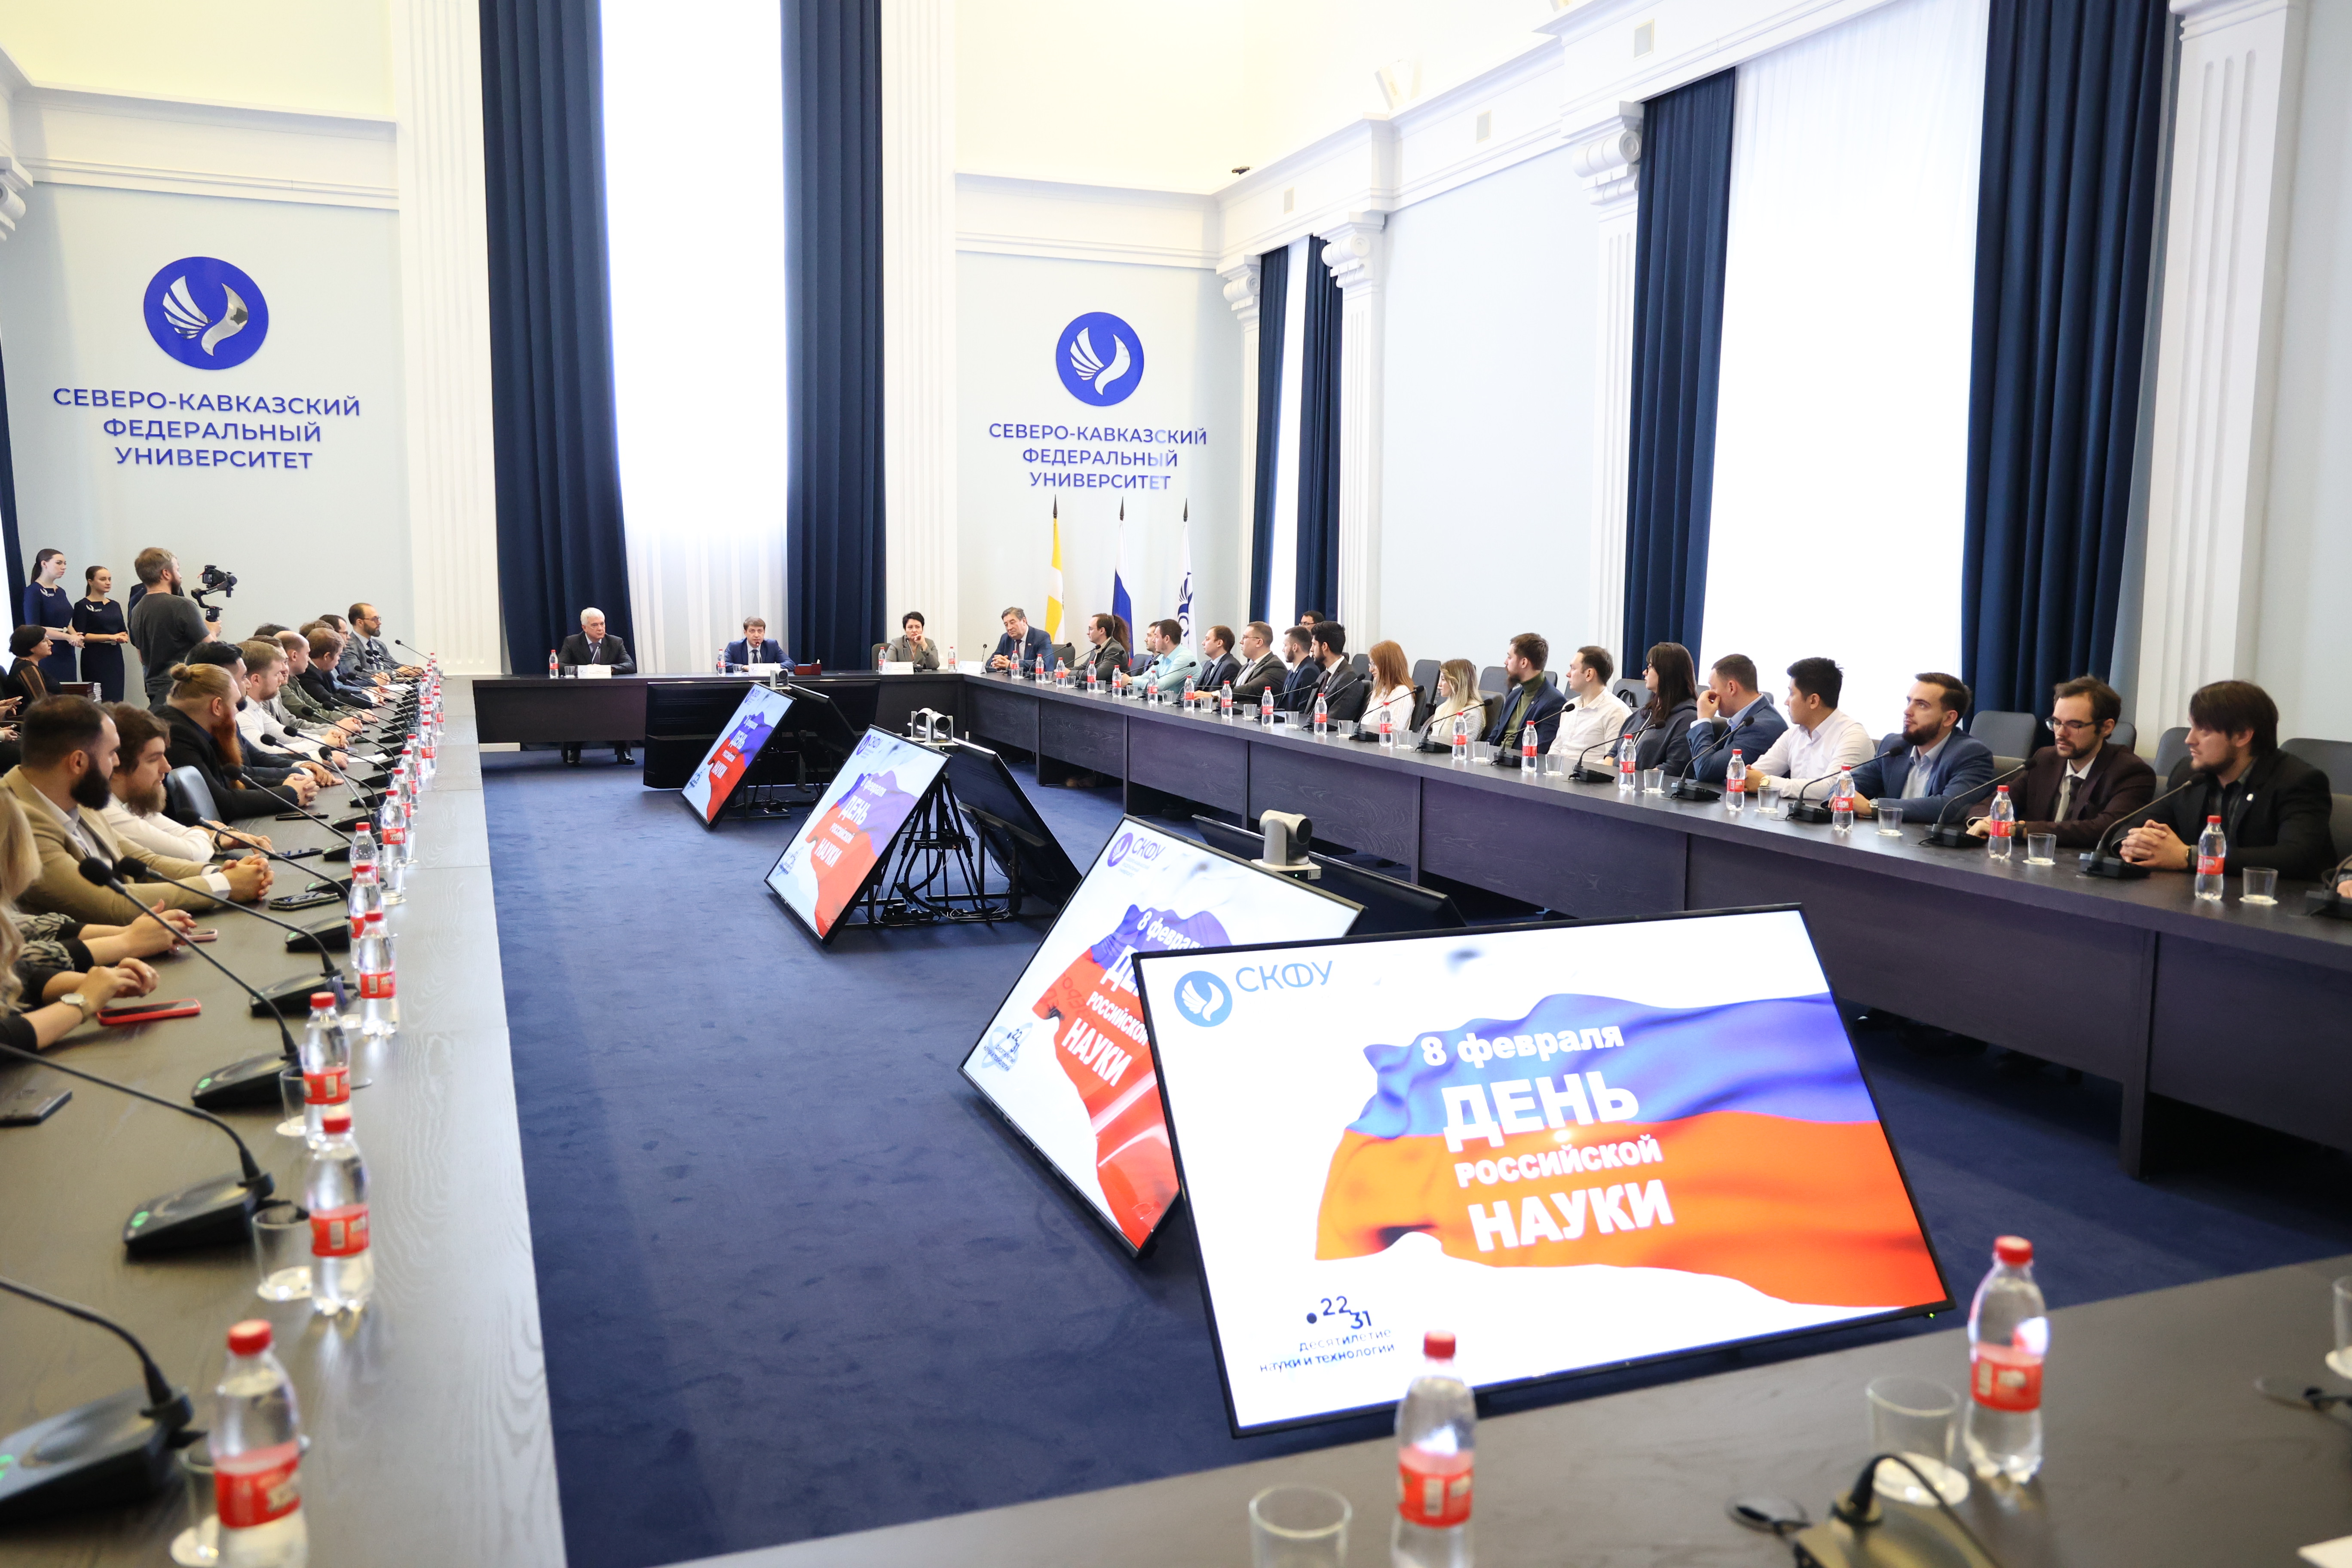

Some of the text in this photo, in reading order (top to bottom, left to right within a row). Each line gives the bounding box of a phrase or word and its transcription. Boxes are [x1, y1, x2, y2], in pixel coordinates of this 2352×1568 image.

[53, 388, 360, 416] СЕВЕРО-КАВКАЗСКИЙ
[103, 418, 321, 442] ФЕДЕРАЛЬНЫЙ
[989, 423, 1207, 444] СЕВЕРО-КАВКАЗСКИЙ
[114, 447, 313, 469] УНИВЕРСИТЕТ
[1023, 448, 1177, 467] ФЕДЕРАЛЬНЫЙ
[1029, 472, 1171, 490] УНИВЕРСИТЕТ
[861, 775, 887, 797] 8 февраля
[838, 795, 871, 825] ДЕНЬ
[830, 822, 855, 844] РОССИЙСКОЙ
[814, 838, 842, 867] НАУКИ
[1132, 838, 1166, 861] СКФУ
[1137, 911, 1152, 931] 8
[1236, 961, 1332, 992] СКФУ
[1061, 1017, 1132, 1087] НАУКИ
[1421, 1026, 1624, 1069] 8 февраля
[1441, 1071, 1639, 1152] ДЕНЬ
[1454, 1133, 1663, 1188] РОССИЙСКОЙ
[1467, 1179, 1674, 1251] НАУКИ
[1321, 1295, 1351, 1316] 22
[1350, 1311, 1372, 1329] 31
[1299, 1329, 1391, 1352] десятилетие
[1260, 1359, 1301, 1373] науки
[1304, 1357, 1312, 1366] и
